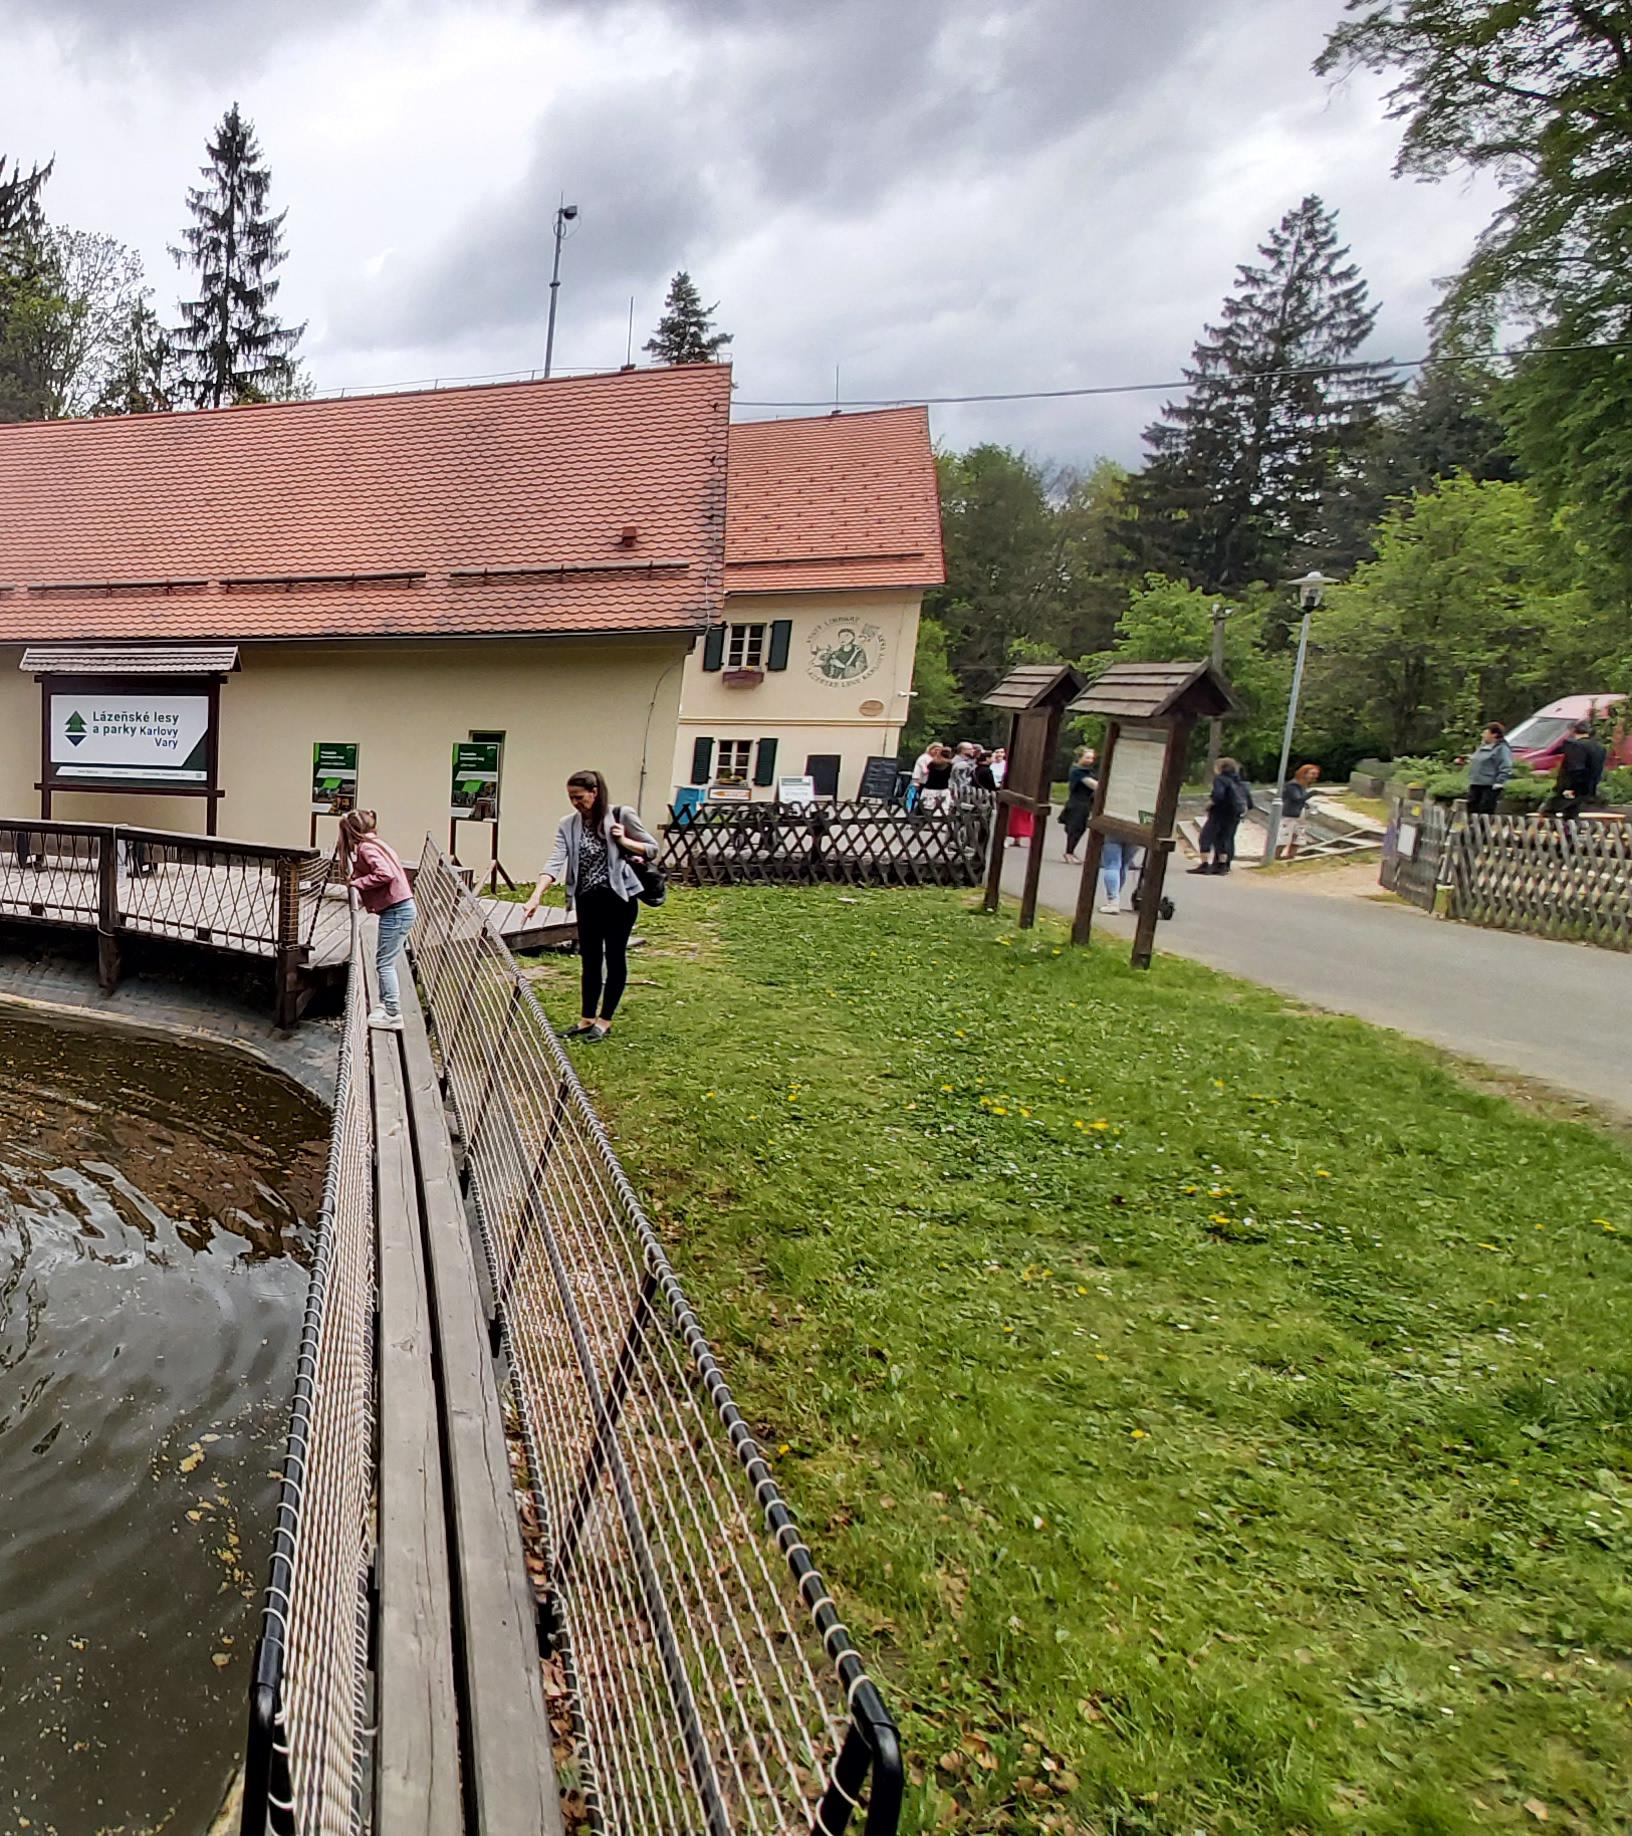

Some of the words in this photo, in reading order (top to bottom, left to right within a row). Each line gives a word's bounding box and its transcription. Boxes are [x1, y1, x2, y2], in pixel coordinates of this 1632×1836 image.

[154, 711, 179, 725] lesy
[92, 725, 99, 734] a
[103, 723, 137, 737] parky
[139, 725, 179, 738] Karlovy
[154, 737, 178, 750] Vary
